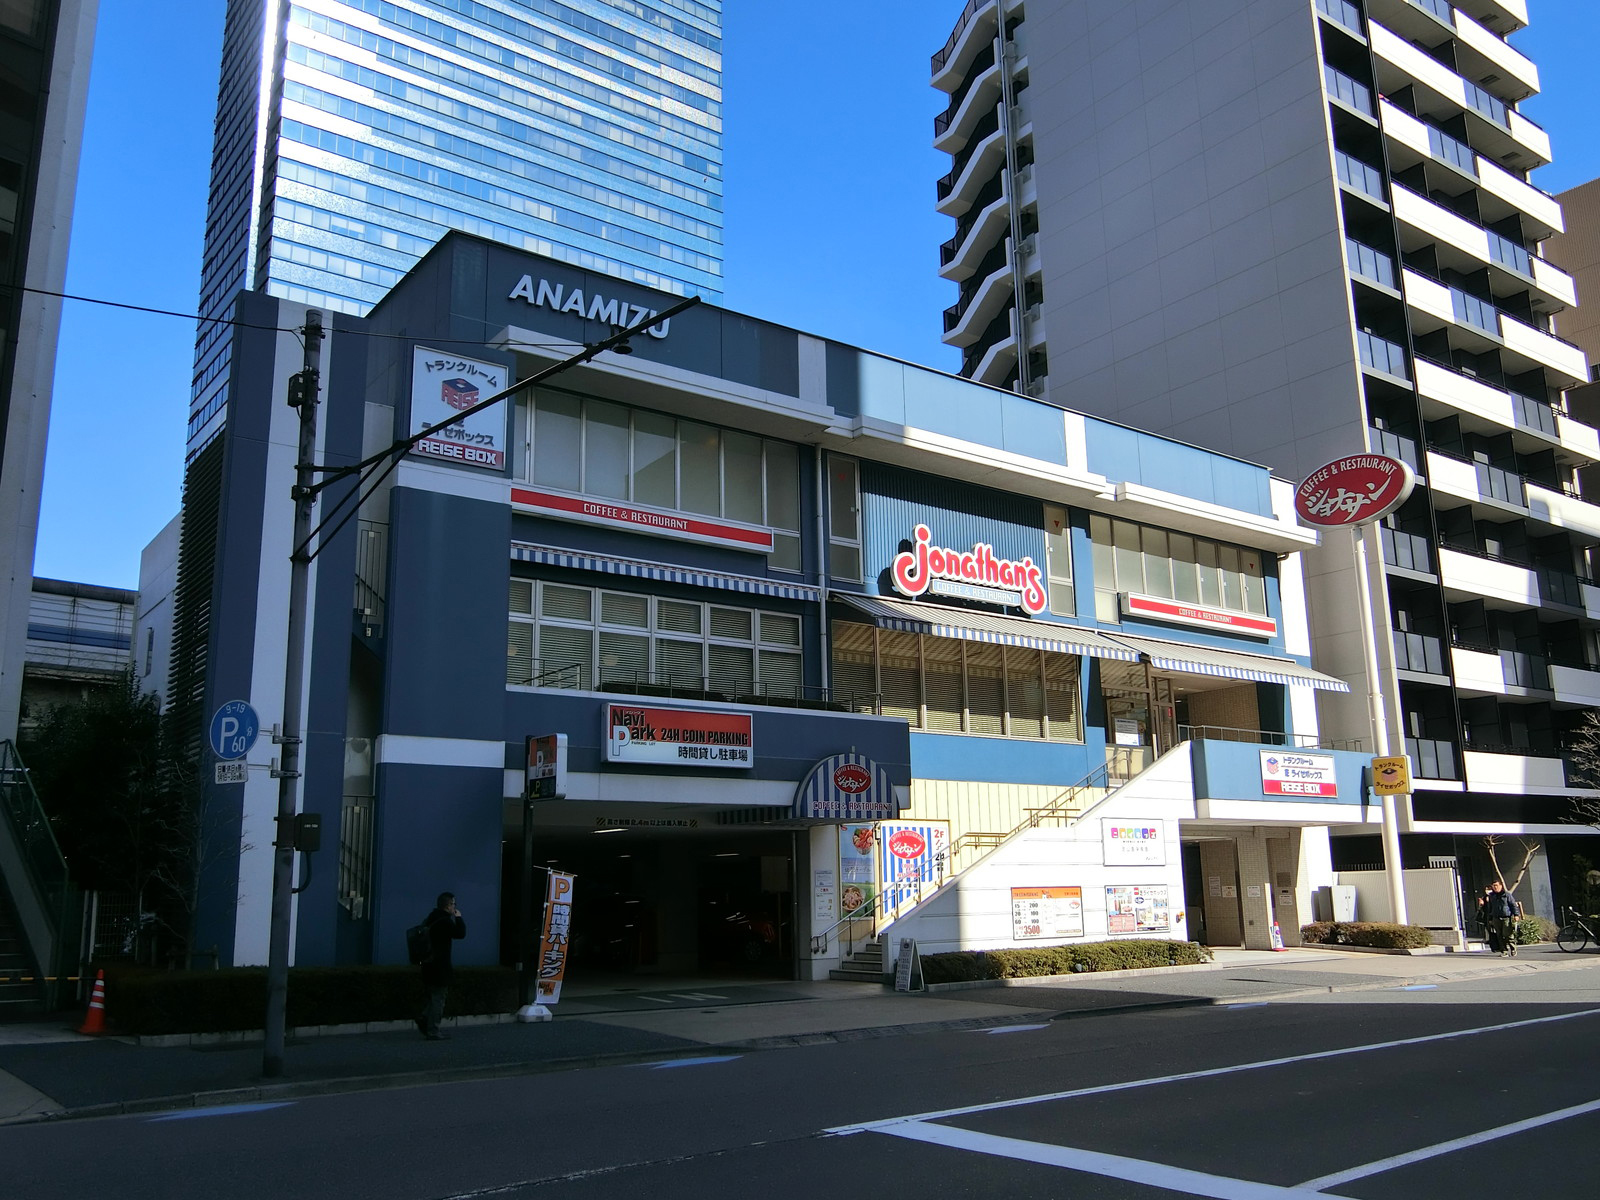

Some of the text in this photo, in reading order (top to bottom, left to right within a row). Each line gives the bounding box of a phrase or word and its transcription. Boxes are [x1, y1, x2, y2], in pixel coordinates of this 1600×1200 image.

[509, 274, 670, 340] ANAMIZU
[425, 360, 497, 388] トランクルーム
[418, 439, 497, 466] REISE BOX
[1300, 457, 1398, 497] COFFEE & RESTAURANT
[583, 503, 688, 530] COFFEE & RESTAURANT
[937, 582, 1016, 603] COFFEE & RESTAURANT
[1178, 607, 1196, 618] COFFEE
[1203, 611, 1232, 624] RESTAURANT
[226, 703, 246, 714] 9-19
[612, 709, 645, 727] Navi
[219, 717, 239, 754] P
[232, 736, 246, 753] 60
[661, 728, 748, 746] 24H COIN PARKING
[678, 746, 748, 762] 時間貸し駐車場
[1282, 757, 1314, 766] トランクルーム
[1375, 762, 1404, 771] トランクルーム
[812, 801, 840, 811] COFFEE
[848, 801, 892, 812] RESTAURANT
[934, 829, 944, 839] 2F
[554, 877, 570, 900] P
[1023, 925, 1040, 935] 3500
